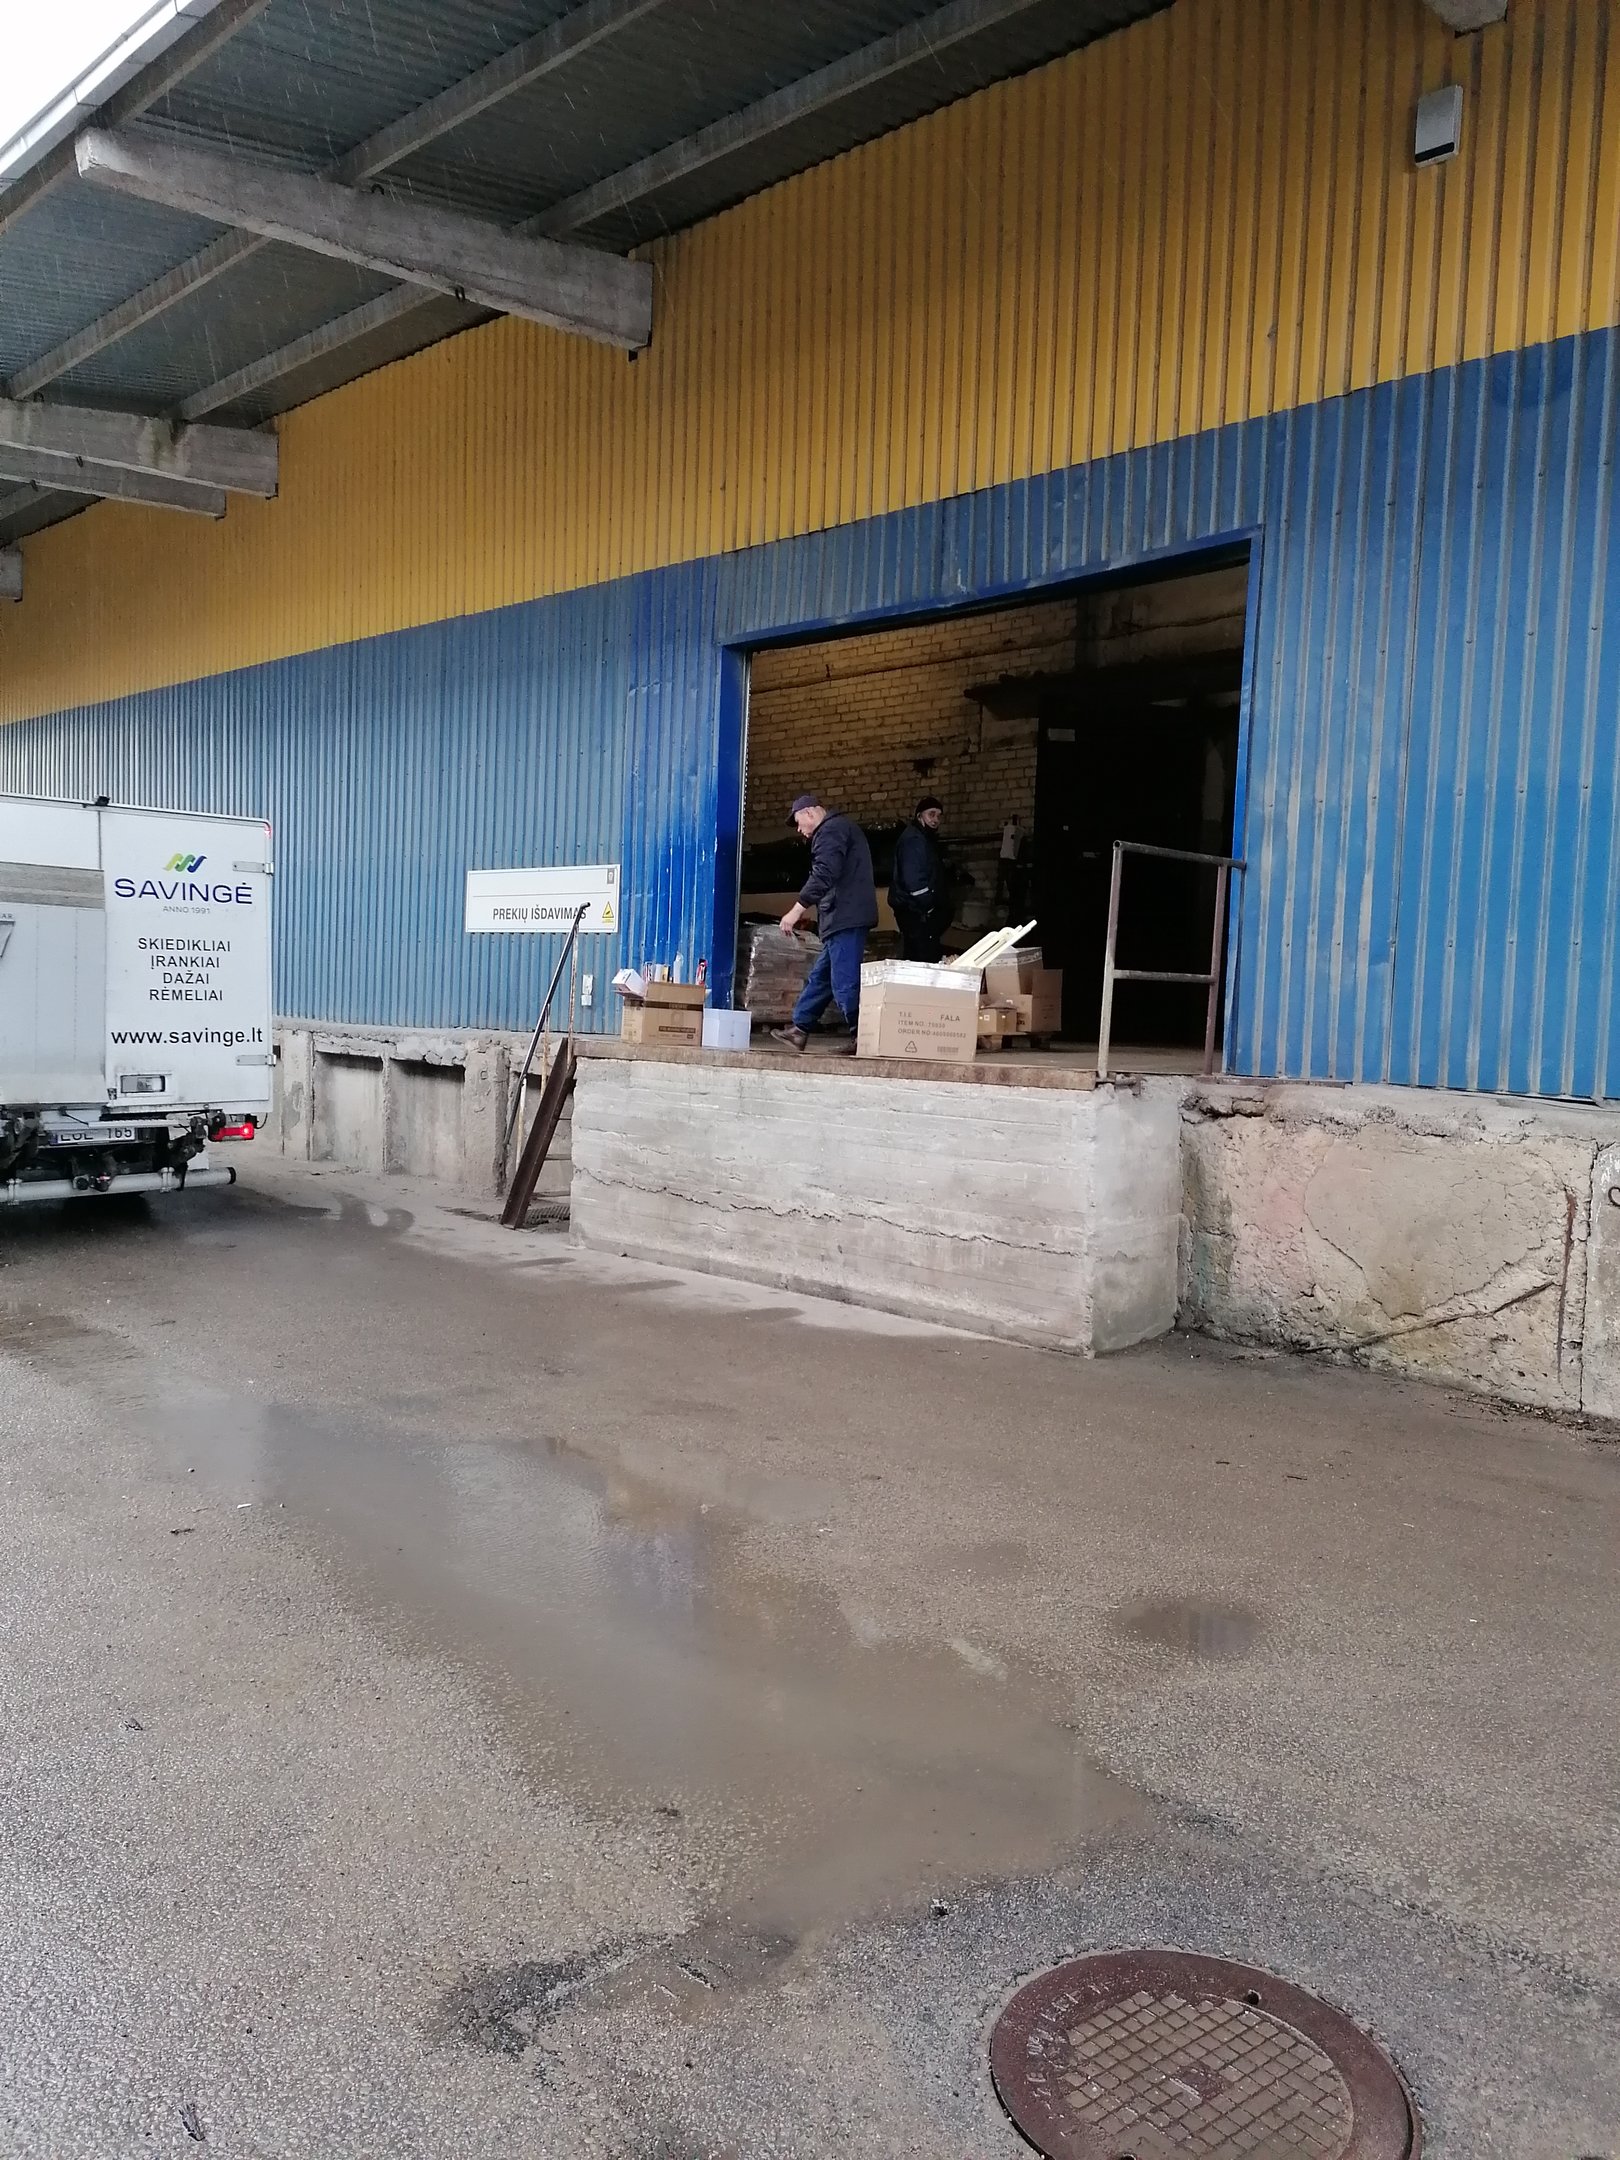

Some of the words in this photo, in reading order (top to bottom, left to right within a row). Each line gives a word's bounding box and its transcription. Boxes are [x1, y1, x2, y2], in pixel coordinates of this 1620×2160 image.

[114, 878, 253, 905] SAVINGĖ
[162, 905, 189, 914] ANNO
[191, 907, 211, 915] 1991
[492, 907, 529, 923] PREKIŲ
[138, 937, 231, 952] SKIEDIKLIAI
[150, 955, 220, 970] ĮRANKIAI
[163, 969, 210, 985] DAŽAI
[149, 986, 223, 1001] RĖMELIAI
[111, 1027, 263, 1047] www.savinge.lt
